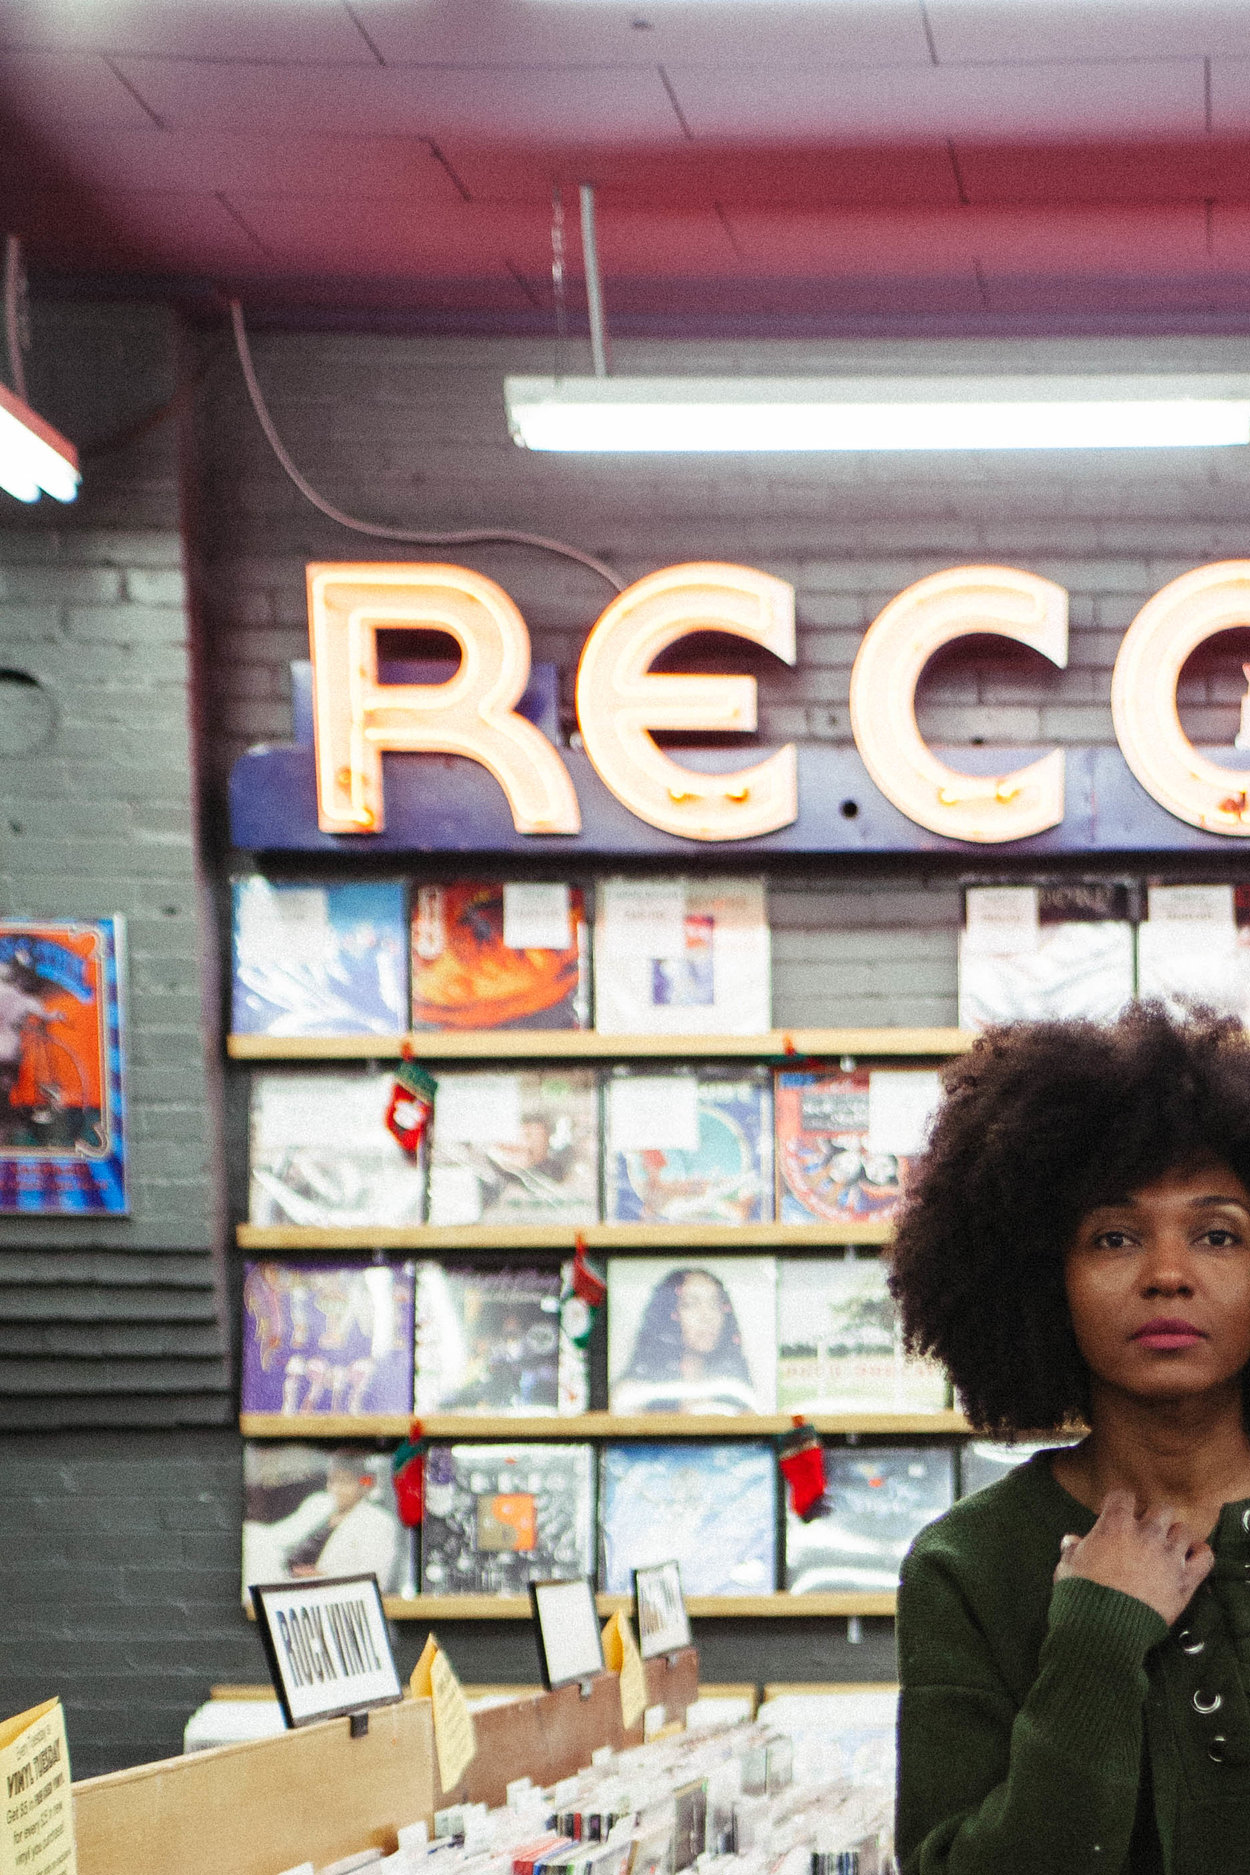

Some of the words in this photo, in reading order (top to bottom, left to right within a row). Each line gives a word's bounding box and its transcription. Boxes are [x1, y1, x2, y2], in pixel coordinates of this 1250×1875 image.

[275, 1605, 338, 1688] ROCK
[325, 1600, 382, 1677] VINYL
[7, 1760, 35, 1799] VINYL
[33, 1737, 61, 1781] TUESDAY
